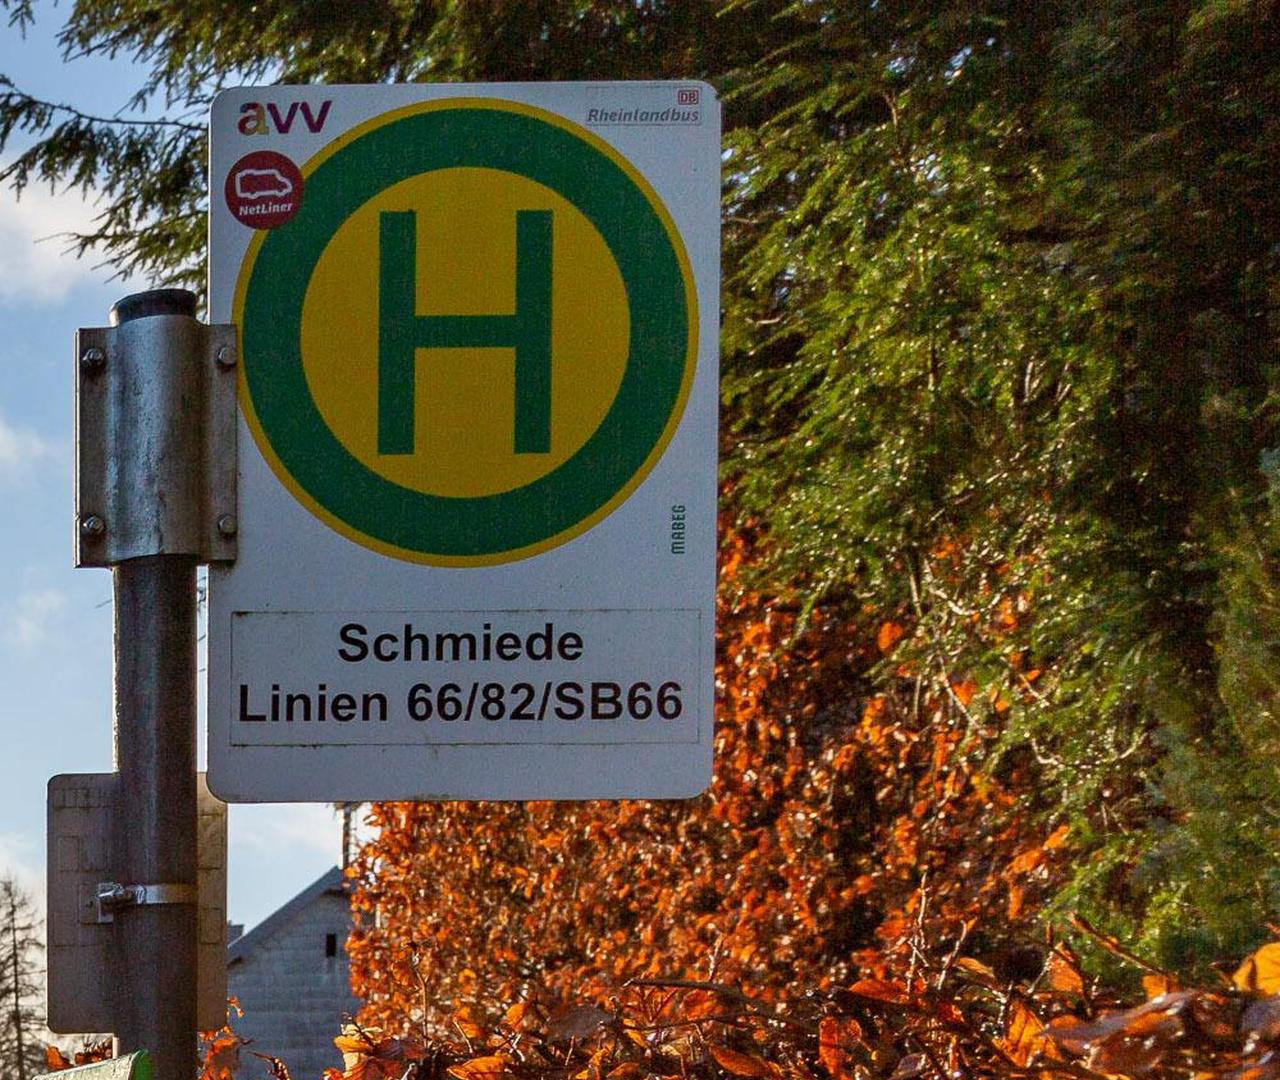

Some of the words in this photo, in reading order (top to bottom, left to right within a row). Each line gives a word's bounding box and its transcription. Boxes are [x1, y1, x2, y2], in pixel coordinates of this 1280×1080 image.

[586, 107, 700, 124] Rheinlandbus
[679, 90, 698, 104] DB
[238, 100, 332, 136] avv
[239, 200, 293, 217] NetLiner
[378, 210, 553, 455] H
[671, 504, 686, 555] MABEG
[338, 622, 584, 663] Schmiede
[238, 684, 388, 723] Linien
[407, 681, 684, 723] 66/82/SB66
